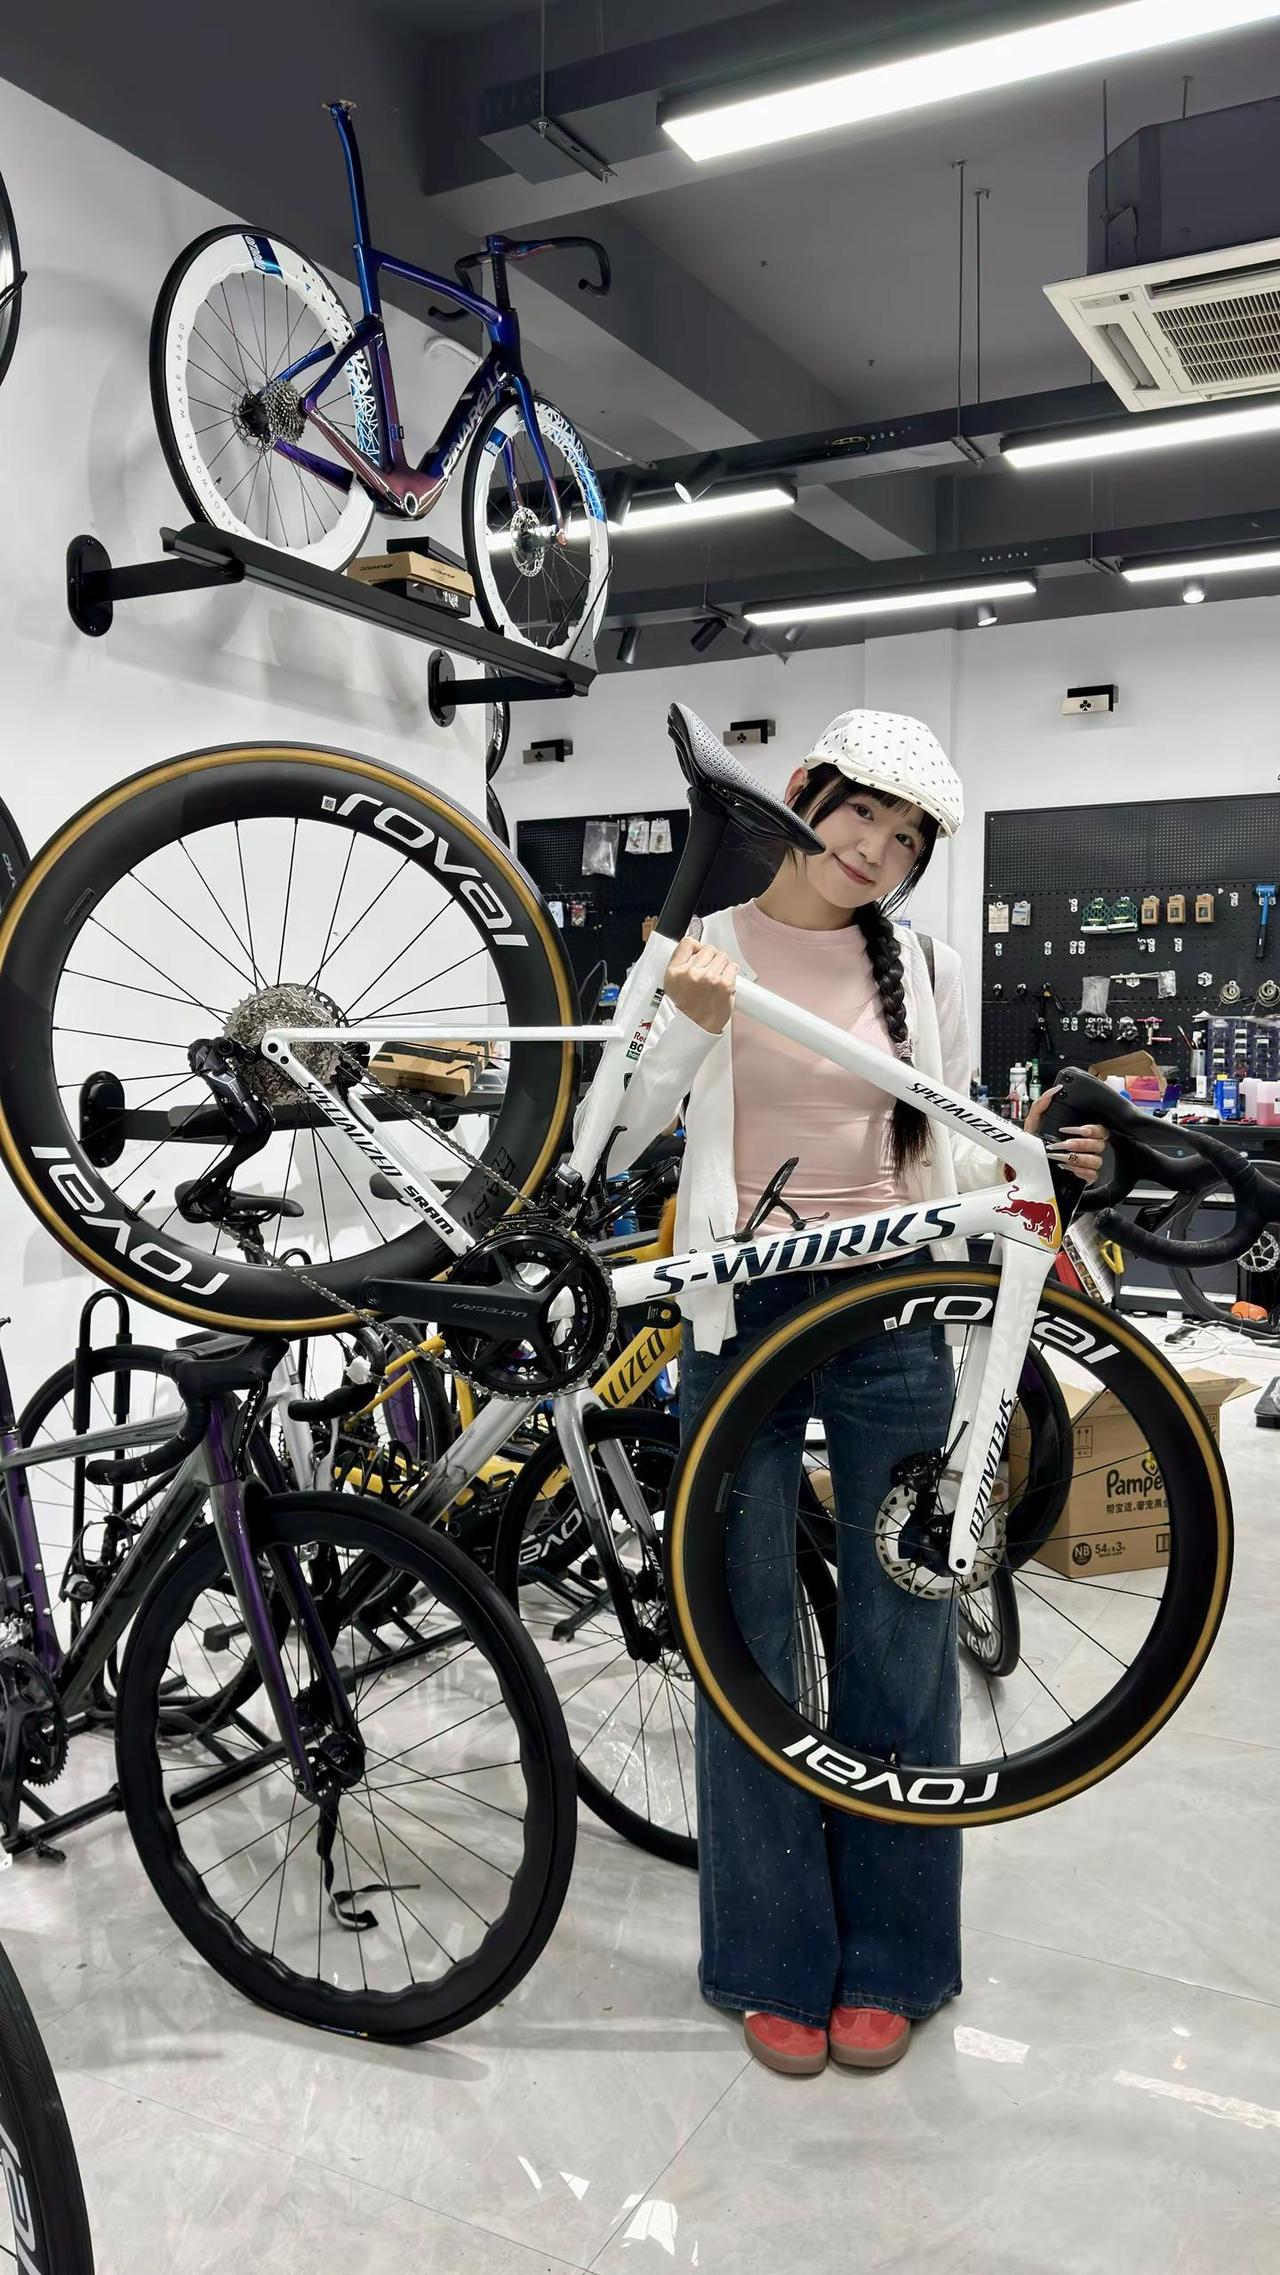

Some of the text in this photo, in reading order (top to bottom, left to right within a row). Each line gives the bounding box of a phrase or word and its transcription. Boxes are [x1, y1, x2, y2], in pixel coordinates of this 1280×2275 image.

[336, 793, 529, 946] roval
[299, 1082, 403, 1177] SPECIALIZED
[905, 1082, 1015, 1143] SPECIALIZED
[31, 1146, 230, 1295] roval
[403, 1185, 455, 1237] SRAM
[646, 1203, 962, 1299] S-WORKS
[451, 1302, 528, 1318] ULTEGRA
[899, 1296, 1120, 1364] roal
[969, 1389, 1013, 1542] SPECIALIZED
[1106, 1469, 1164, 1498] Pampe
[519, 1508, 583, 1565] ova
[1075, 1545, 1089, 1557] NB
[782, 1734, 998, 1805] roval
